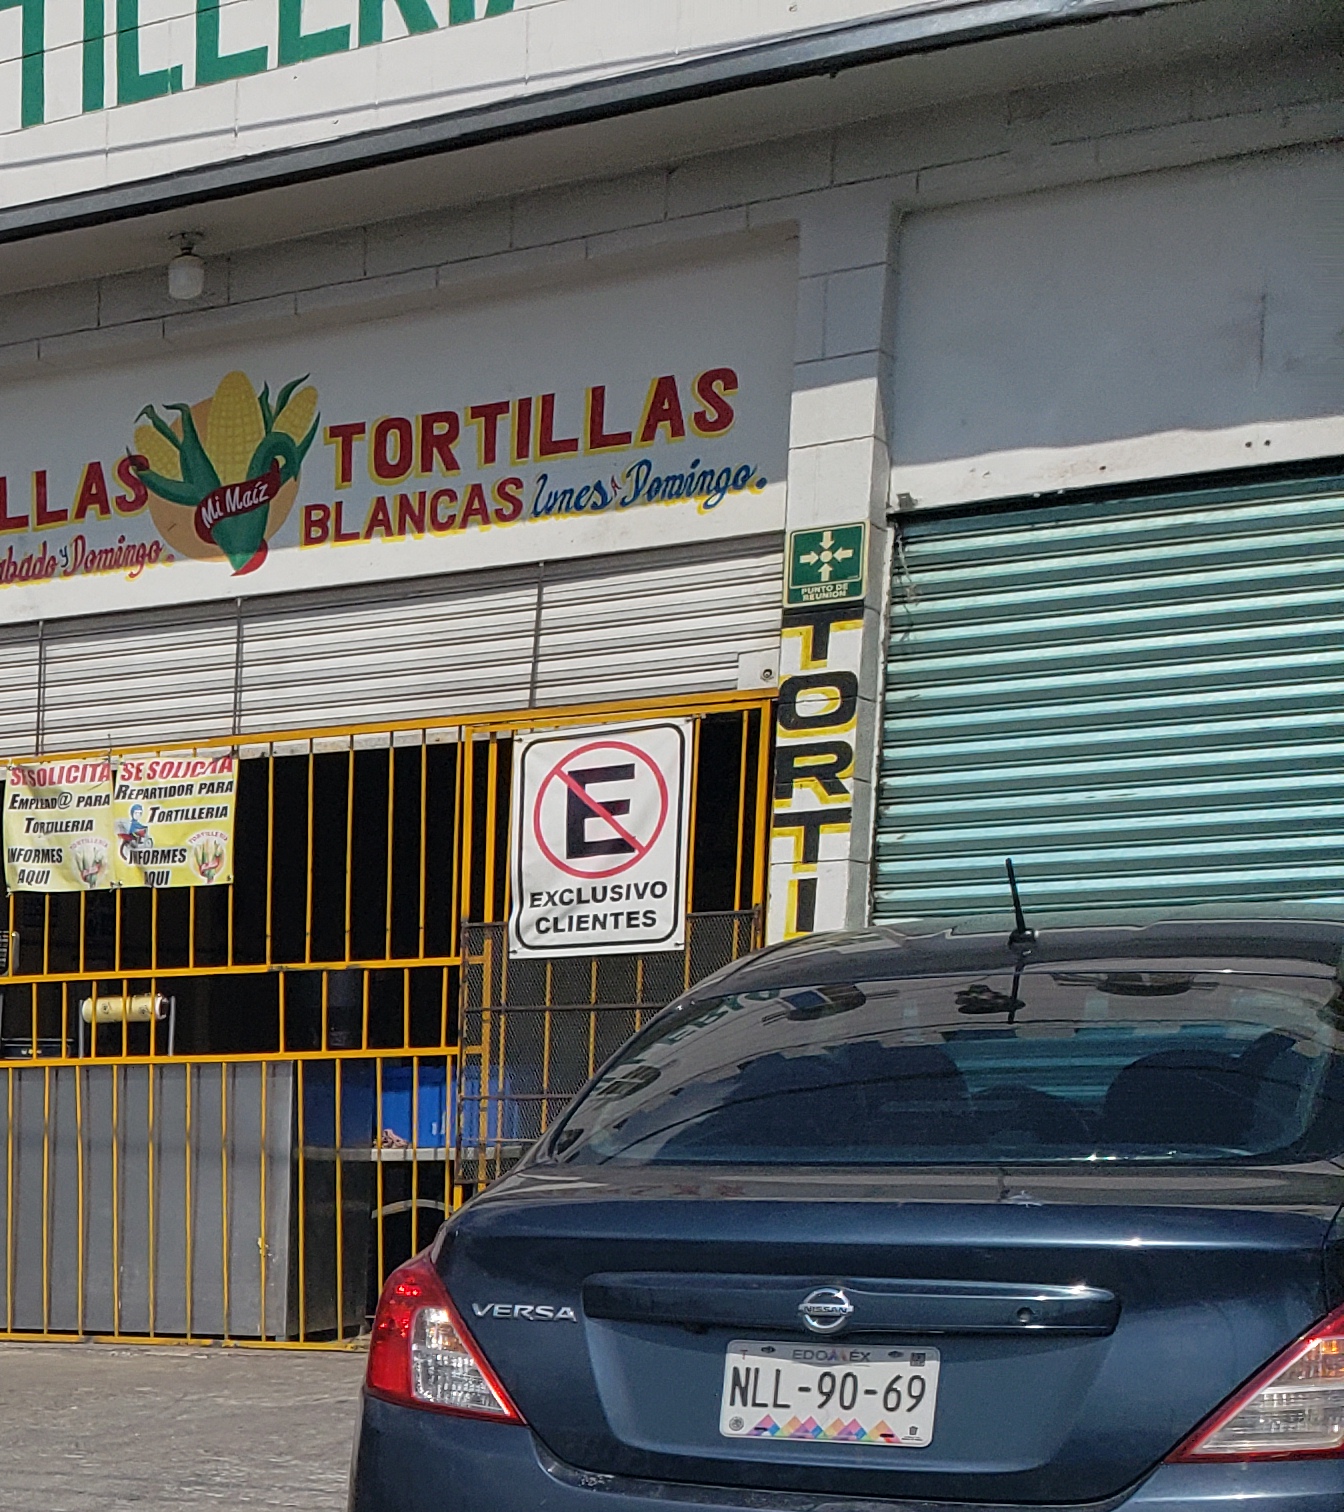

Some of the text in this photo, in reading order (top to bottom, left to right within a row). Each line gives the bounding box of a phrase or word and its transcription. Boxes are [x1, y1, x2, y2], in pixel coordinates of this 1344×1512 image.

[326, 368, 739, 487] TORTILLAS
[200, 502, 223, 529] Mi
[302, 477, 524, 547] BLANCAS
[801, 582, 849, 595] PUNTO DE
[28, 763, 111, 787] SOLICITA
[120, 761, 143, 782] SE
[76, 793, 111, 808] PARA
[114, 780, 235, 801] REPARTIDOR PARA
[147, 805, 229, 824] TORTILLERIA
[24, 817, 94, 835] TORTILLERIA
[7, 847, 63, 864] INFORMES
[128, 847, 187, 865] INFORMES
[17, 868, 51, 885] AQUI
[529, 880, 668, 909] EXCLUSIVO
[535, 909, 658, 935] CLIENTES
[472, 1302, 578, 1323] VERSA
[802, 1305, 848, 1314] NISSAN
[728, 1365, 927, 1414] NLL-90-69
